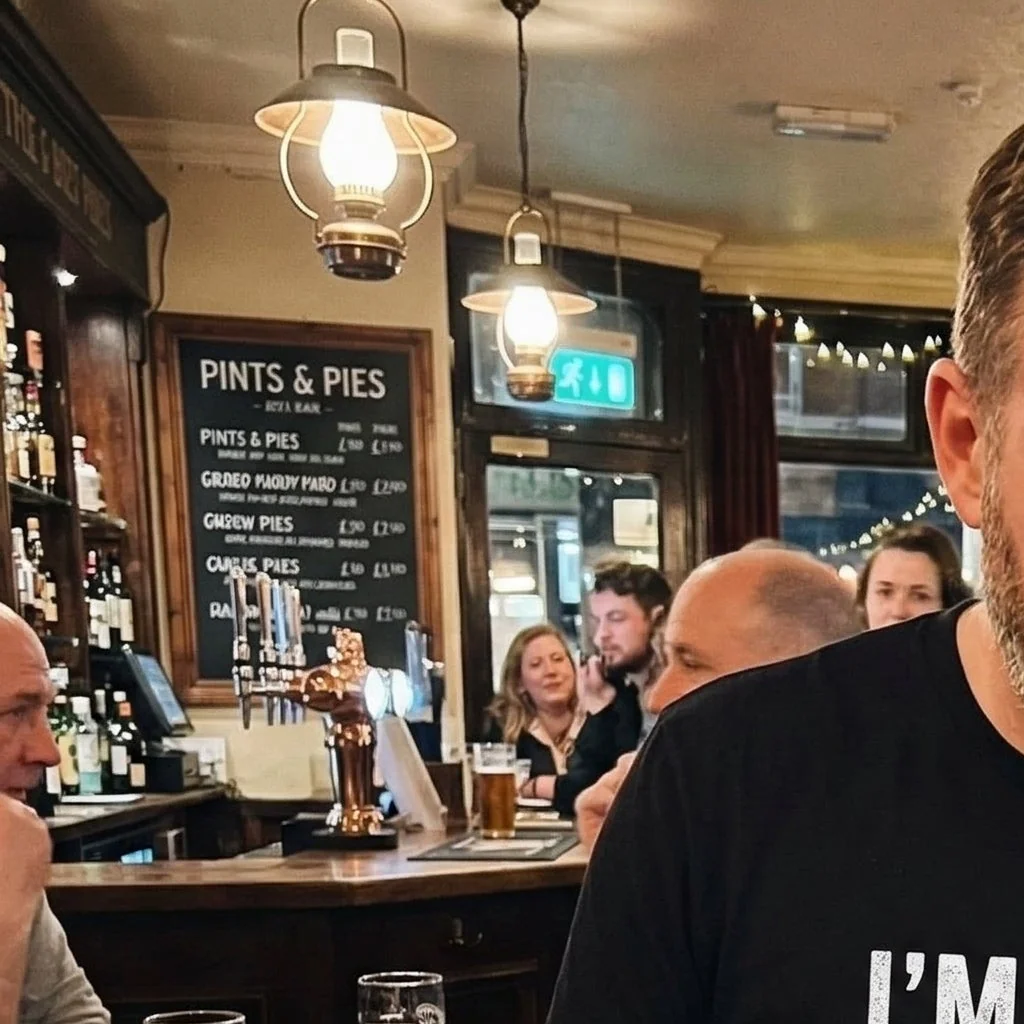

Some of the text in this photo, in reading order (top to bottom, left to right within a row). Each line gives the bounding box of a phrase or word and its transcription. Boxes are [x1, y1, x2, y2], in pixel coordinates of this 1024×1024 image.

[200, 359, 386, 399] PINTS & PIES
[200, 428, 300, 450] PINTS & PIES
[258, 515, 295, 533] PIES
